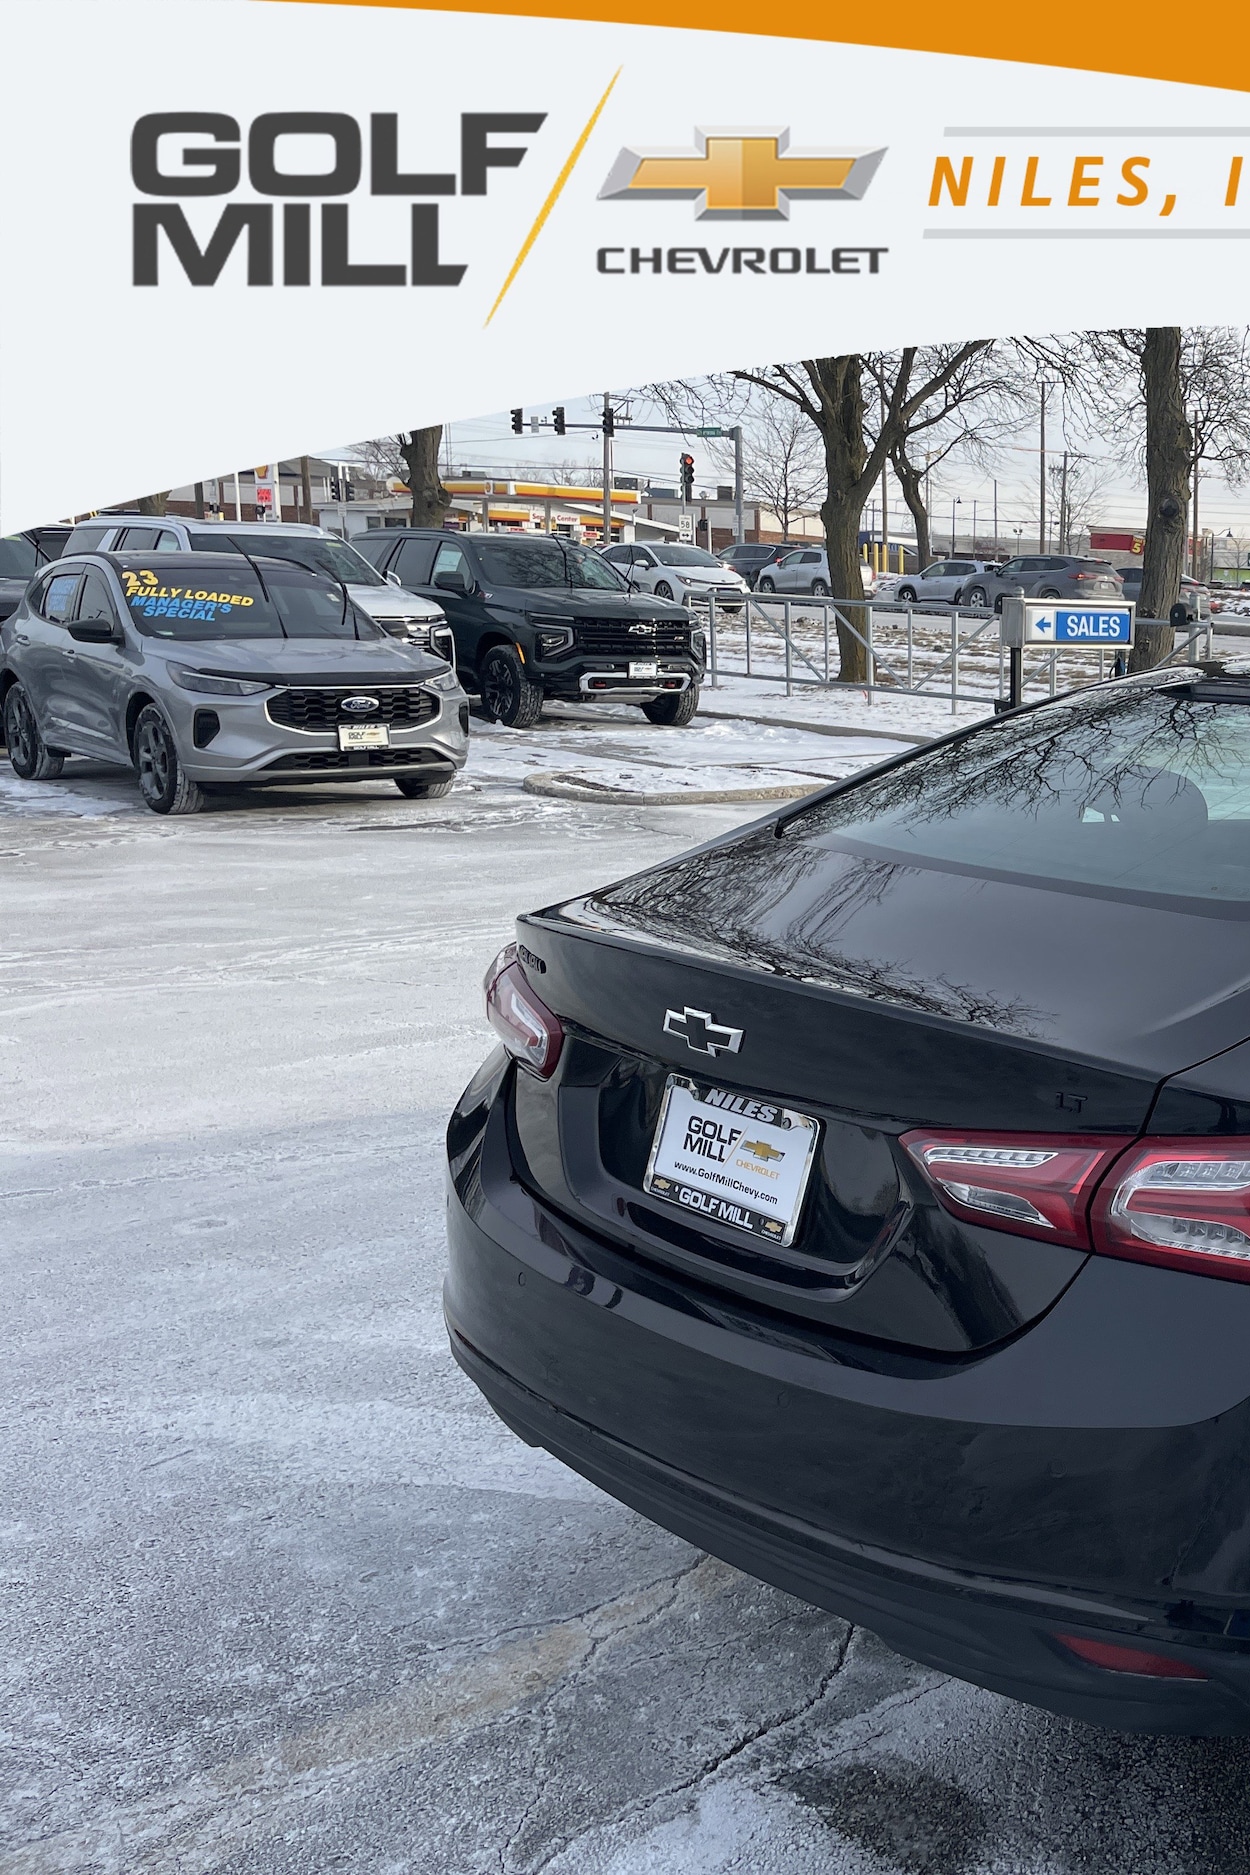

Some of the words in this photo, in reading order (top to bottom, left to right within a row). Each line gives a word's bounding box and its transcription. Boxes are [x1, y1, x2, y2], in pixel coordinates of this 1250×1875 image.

[681, 521, 690, 529] 58
[1132, 543, 1141, 553] 5
[122, 570, 158, 587] 23
[126, 586, 182, 597] FULLY
[184, 589, 254, 606] LOADED
[130, 596, 233, 614] MANAGER'S
[143, 607, 216, 621] SPECIAL
[1066, 615, 1121, 637] SALES
[704, 1088, 779, 1123] NILES
[688, 1115, 742, 1146] GOLF
[683, 1132, 726, 1163] MILL
[735, 1159, 780, 1181] CHEVROLET
[674, 1161, 778, 1205] www.GolfMillChevy.com
[678, 1187, 719, 1213] GOLF
[718, 1205, 753, 1229] MILL
